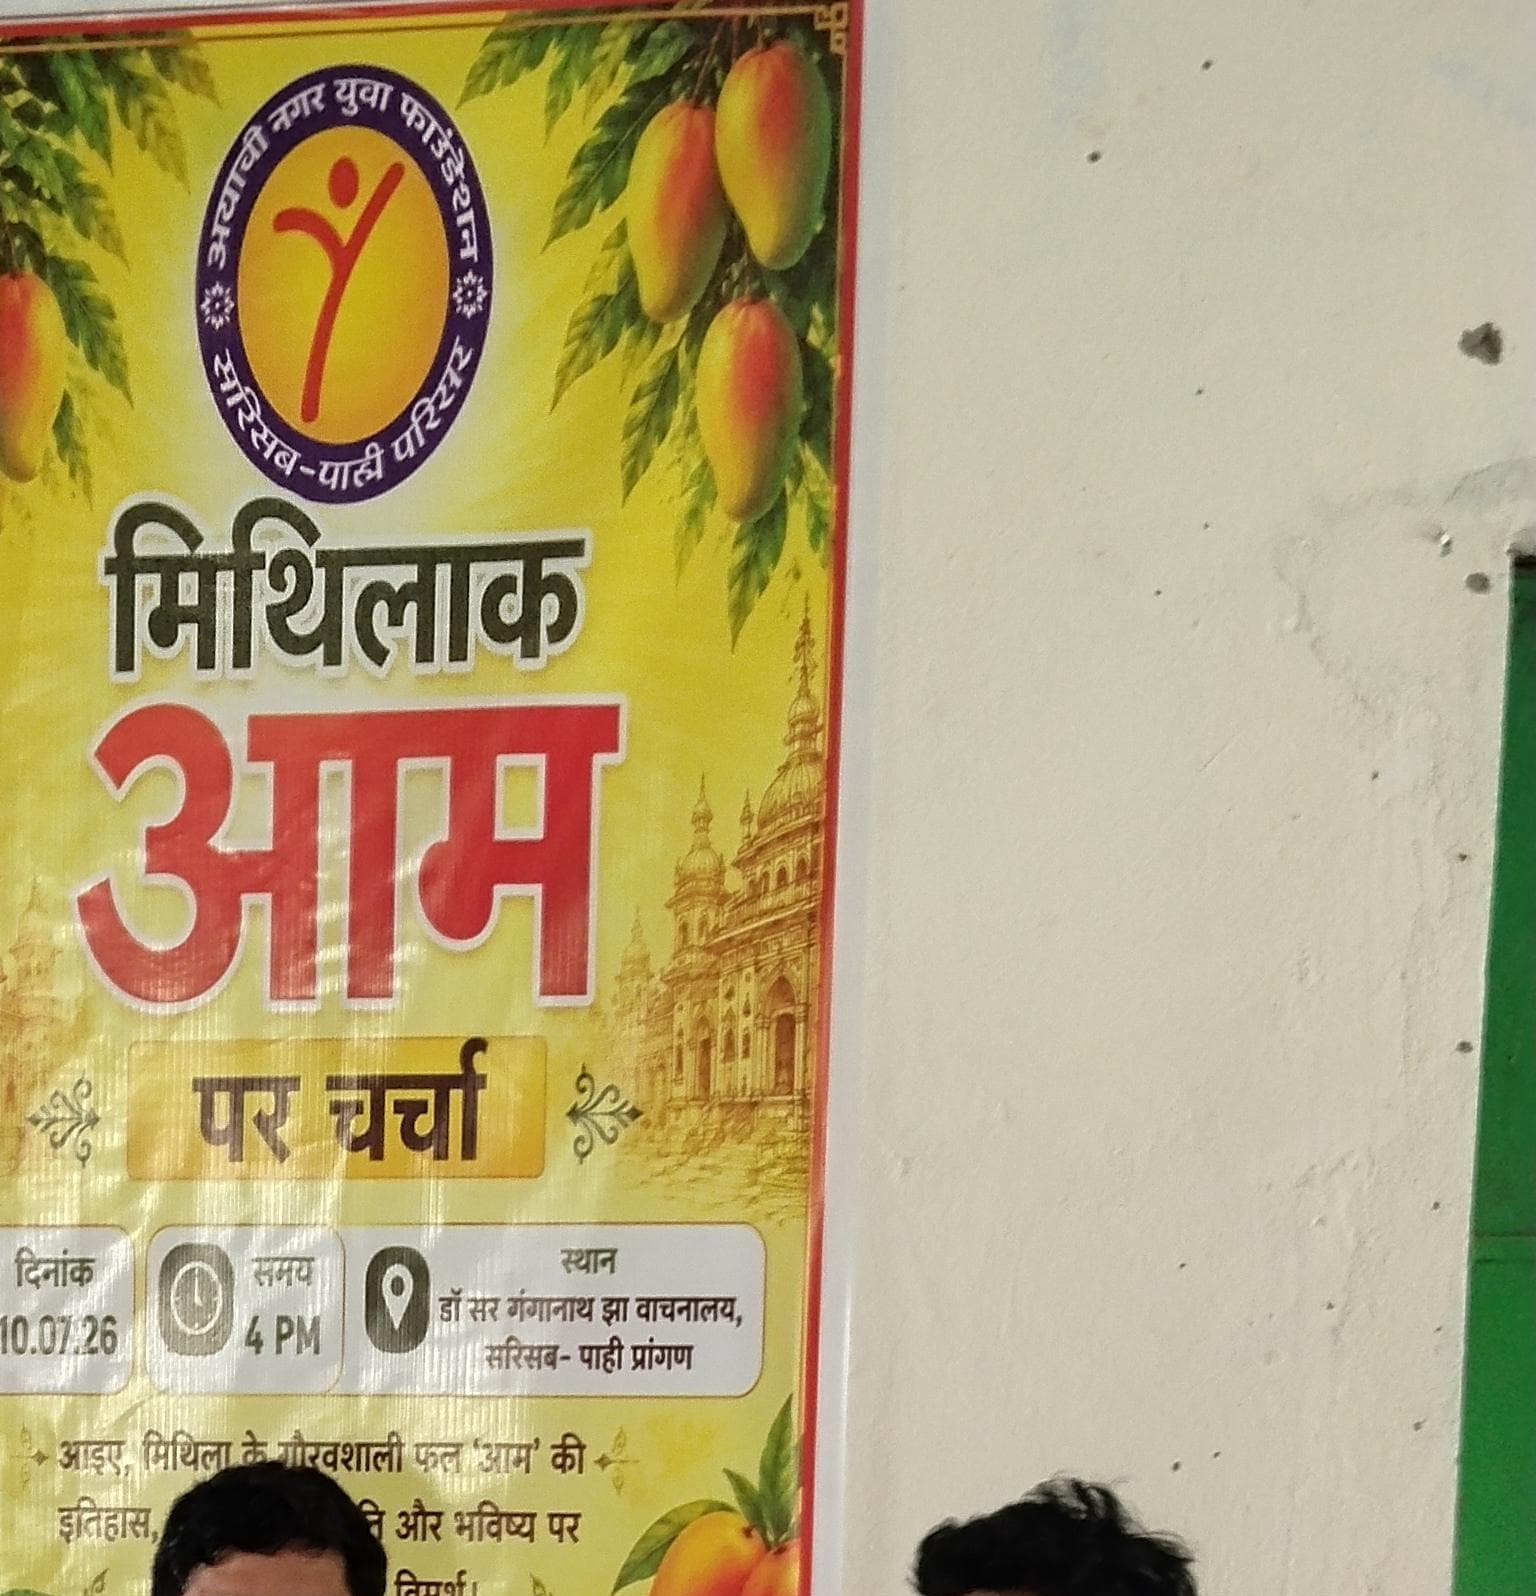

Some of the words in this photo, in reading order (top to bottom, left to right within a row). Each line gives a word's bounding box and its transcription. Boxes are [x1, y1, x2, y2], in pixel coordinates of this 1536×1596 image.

[268, 80, 328, 136] नगर
[334, 77, 393, 117] युवा
[399, 92, 478, 262] फाउंडेशन
[104, 497, 585, 673] मिथिलाक
[76, 702, 621, 1002] आम
[192, 1075, 301, 1163] पर
[326, 1037, 488, 1161] चर्चा
[14, 1246, 96, 1290] दिनांक
[253, 1255, 315, 1288] समय
[561, 1246, 617, 1275] स्थान
[438, 1289, 464, 1322] डॉ
[468, 1296, 500, 1323] सर
[506, 1288, 593, 1323] गंगानाथ
[600, 1296, 628, 1326] झा
[635, 1296, 744, 1327] वाचनालय,
[243, 1315, 264, 1355] 4
[275, 1315, 321, 1355] PM
[579, 1335, 624, 1374] पाही
[630, 1337, 694, 1374] प्रांगण
[57, 1439, 130, 1477] आइए,
[142, 1429, 232, 1473] मिथिला
[241, 1430, 268, 1463] के
[278, 1429, 405, 1473] गौरवशाली
[414, 1441, 464, 1474] फल
[551, 1432, 586, 1475] की
[57, 1496, 159, 1545] इतिहास,
[395, 1498, 444, 1542] और
[454, 1500, 537, 1544] भविष्य
[546, 1512, 582, 1544] पर
